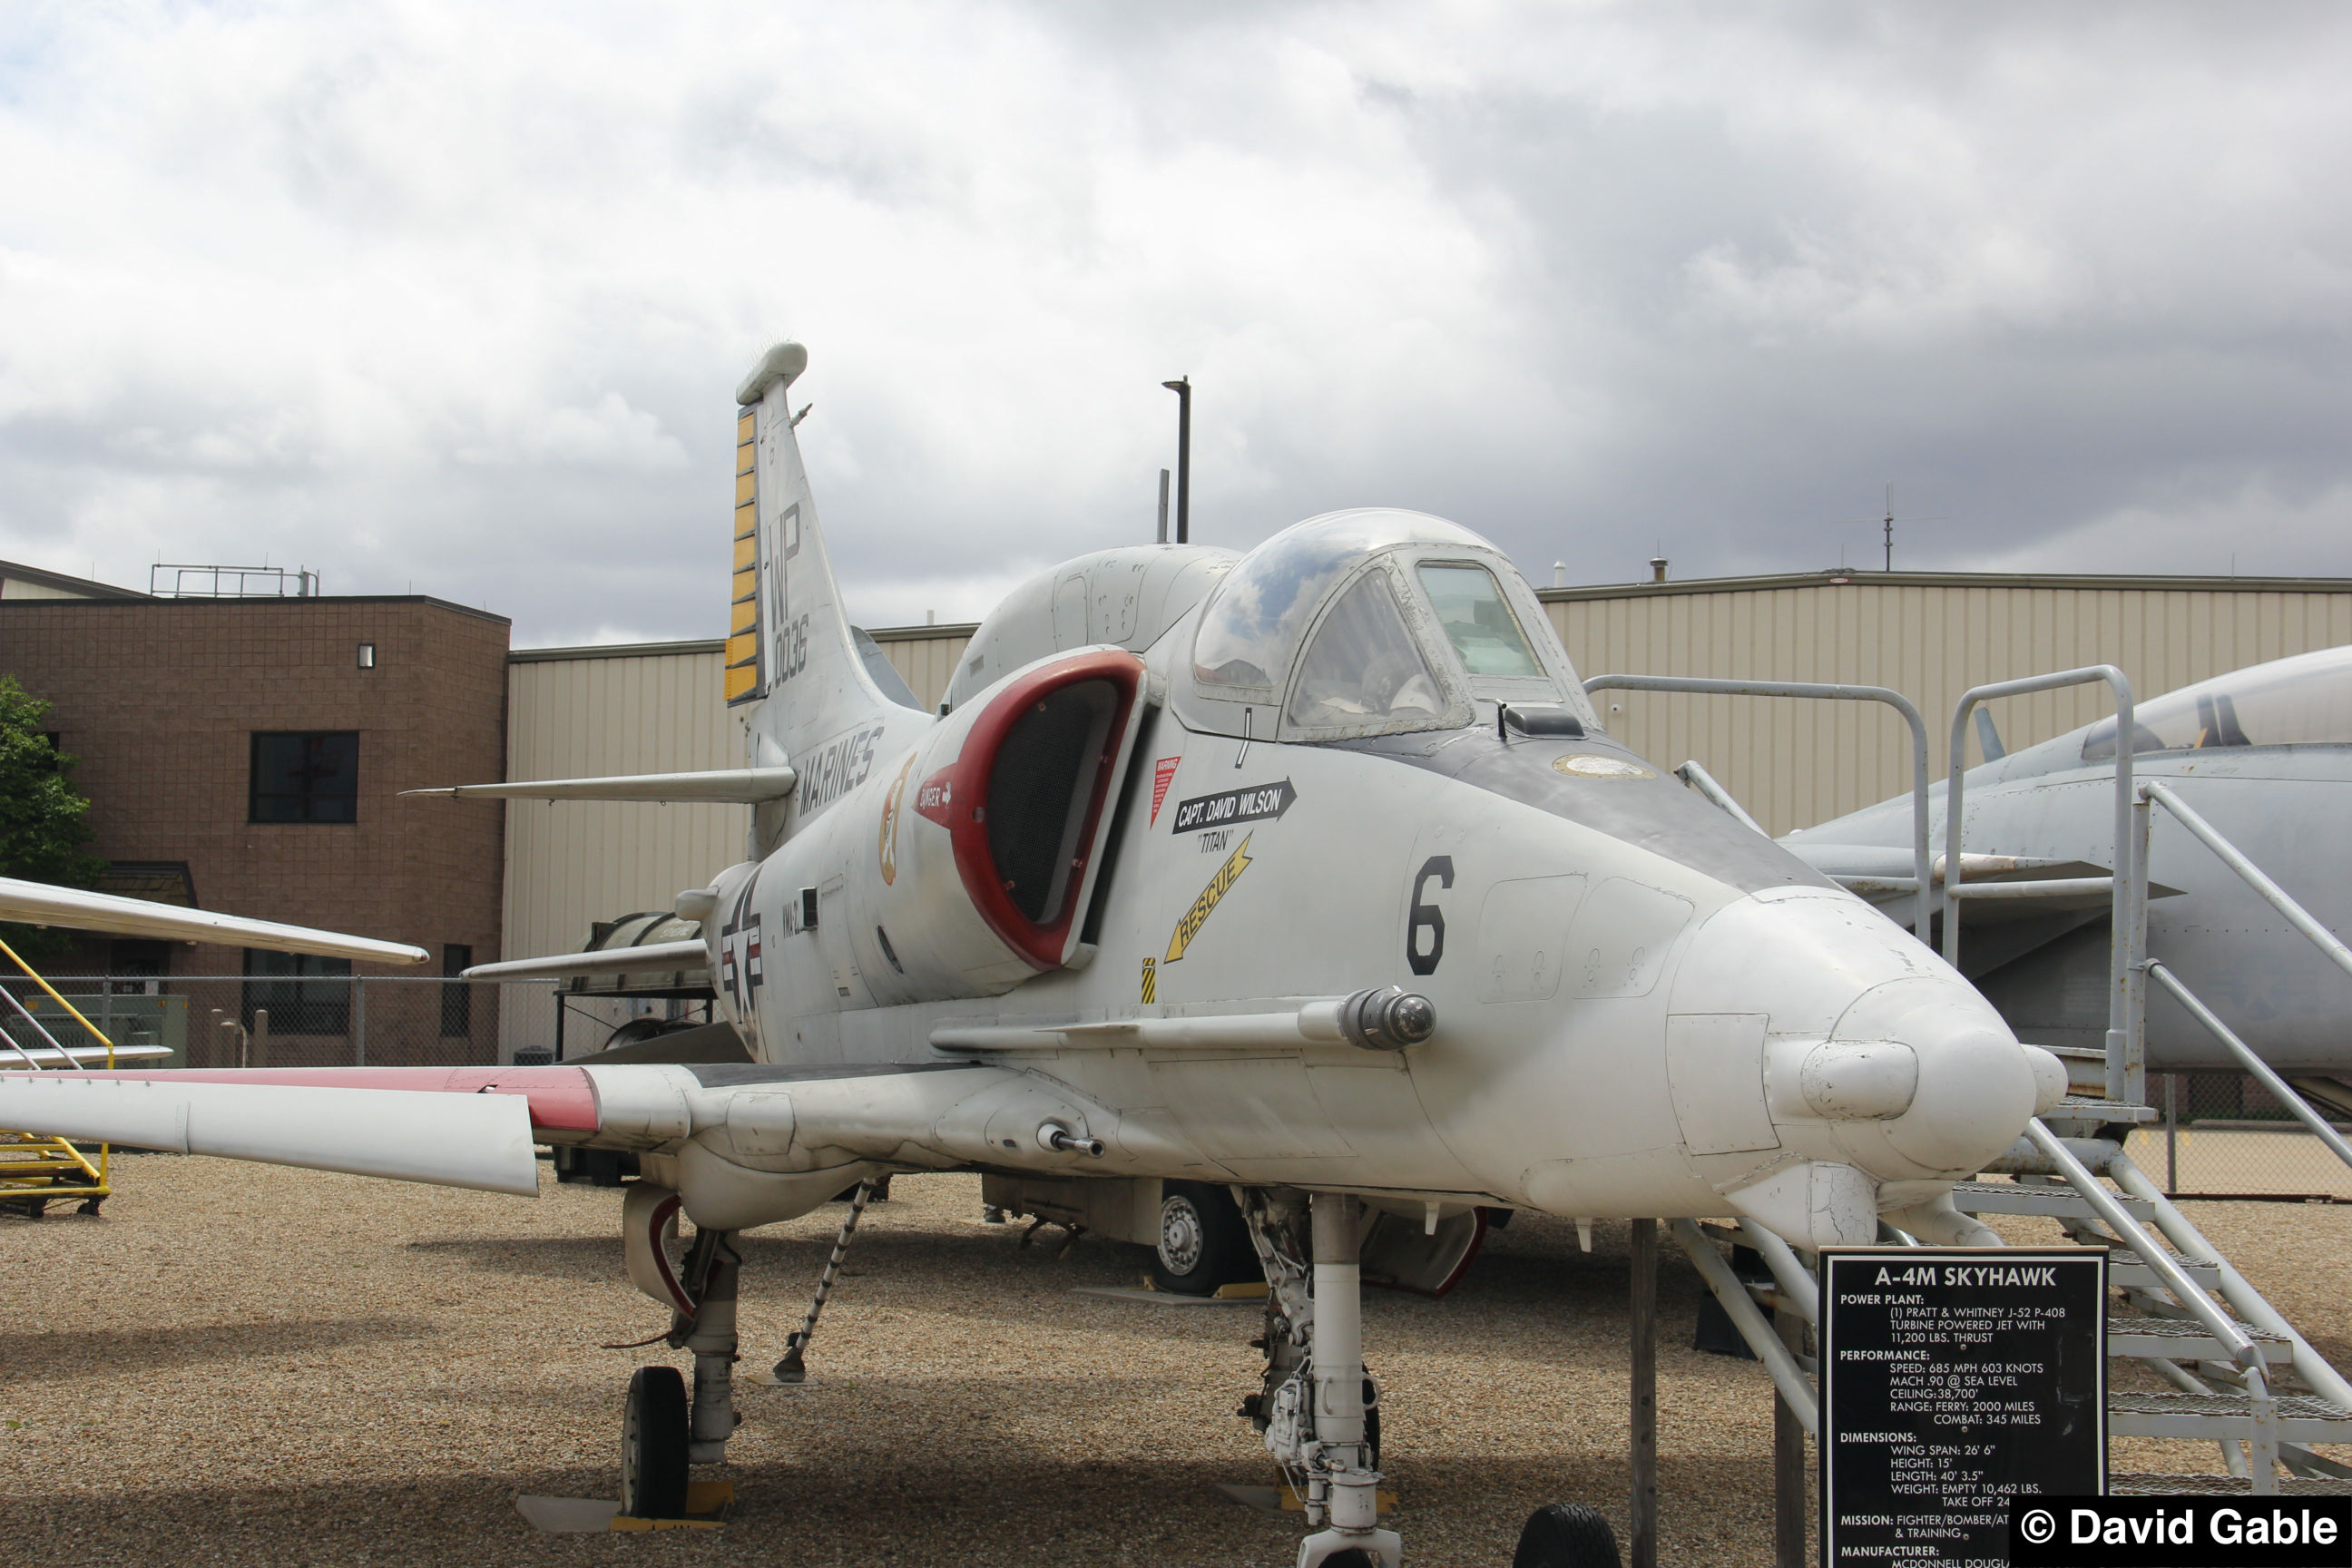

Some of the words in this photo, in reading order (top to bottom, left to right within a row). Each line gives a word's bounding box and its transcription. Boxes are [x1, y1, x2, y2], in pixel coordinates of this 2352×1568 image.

[769, 502, 800, 632] WP
[775, 612, 809, 689] 0036
[799, 726, 885, 818] MARINES
[1179, 802, 1205, 828] CAPT.
[1206, 796, 1236, 822] DAVID
[1239, 789, 1282, 816] WILSON
[1198, 829, 1234, 854] "TITAN"
[1180, 856, 1236, 948] RESCUE
[1406, 856, 1455, 975] 6
[1875, 1267, 1936, 1286] A-4M
[1944, 1267, 2056, 1287] SKYHAWK
[1840, 1294, 1881, 1305] POWER
[1885, 1294, 1925, 1305] PLANT:
[1890, 1307, 1904, 1320] (1)
[1906, 1308, 1938, 1318] PRATT
[1941, 1308, 1950, 1318] &
[1954, 1308, 2004, 1318] WHITNEY
[2007, 1308, 2032, 1318] J-52
[2034, 1308, 2066, 1318] P-408
[1890, 1319, 1935, 1330] TURBINE
[1937, 1319, 1993, 1330] POWERED
[1995, 1319, 2013, 1330] JET
[2015, 1319, 2045, 1330] WITH
[1891, 1333, 1926, 1345] 11,200
[1929, 1333, 1950, 1343] LBS.
[1954, 1333, 1994, 1343] THRUST
[1840, 1349, 1930, 1361] PERFORMANCE:
[1889, 1363, 1926, 1374] SPEED:
[1928, 1363, 1950, 1374] 685
[1953, 1363, 1977, 1374] MPH
[1981, 1363, 2003, 1374] 603
[2005, 1363, 2043, 1374] KNOTS
[1889, 1376, 1924, 1387] MACH
[1926, 1376, 1944, 1387] .90
[1947, 1374, 1961, 1389] @
[1964, 1376, 1984, 1387] SEA
[1988, 1376, 2018, 1387] LEVEL
[1890, 1401, 1933, 1412] RANGE:
[1936, 1401, 1969, 1412] FERRY:
[1973, 1401, 2002, 1412] 2000
[2004, 1401, 2035, 1412] MILES
[1934, 1414, 1983, 1425] COMBAT:
[1986, 1414, 2007, 1425] 345
[2010, 1414, 2041, 1425] MILES
[1840, 1432, 1916, 1443] DIMENSIONS:
[1890, 1445, 1926, 1455] WING
[1929, 1445, 1961, 1455] SPAN:
[1965, 1445, 1980, 1455] 26'
[1890, 1457, 1934, 1468] HEIGHT:
[1937, 1457, 1953, 1468] 15'
[1891, 1471, 1937, 1482] LENGTH:
[1940, 1470, 1957, 1482] 40'
[1961, 1470, 1984, 1482] 3.5"
[1890, 1484, 1939, 1494] WEIGHT:
[1942, 1484, 1977, 1494] EMPTY
[1982, 1484, 2017, 1496] 10,462
[2021, 1484, 2042, 1494] LBS.
[1942, 1496, 1968, 1507] TAKE
[1971, 1496, 1994, 1507] OFF
[1840, 1514, 1894, 1526] MISSION:
[1895, 1527, 1904, 1539] &
[1906, 1527, 1962, 1539] TRAINING
[1841, 1545, 1940, 1557] MANUFACTURER:
[1891, 1559, 1962, 1568] MCDONNELL
